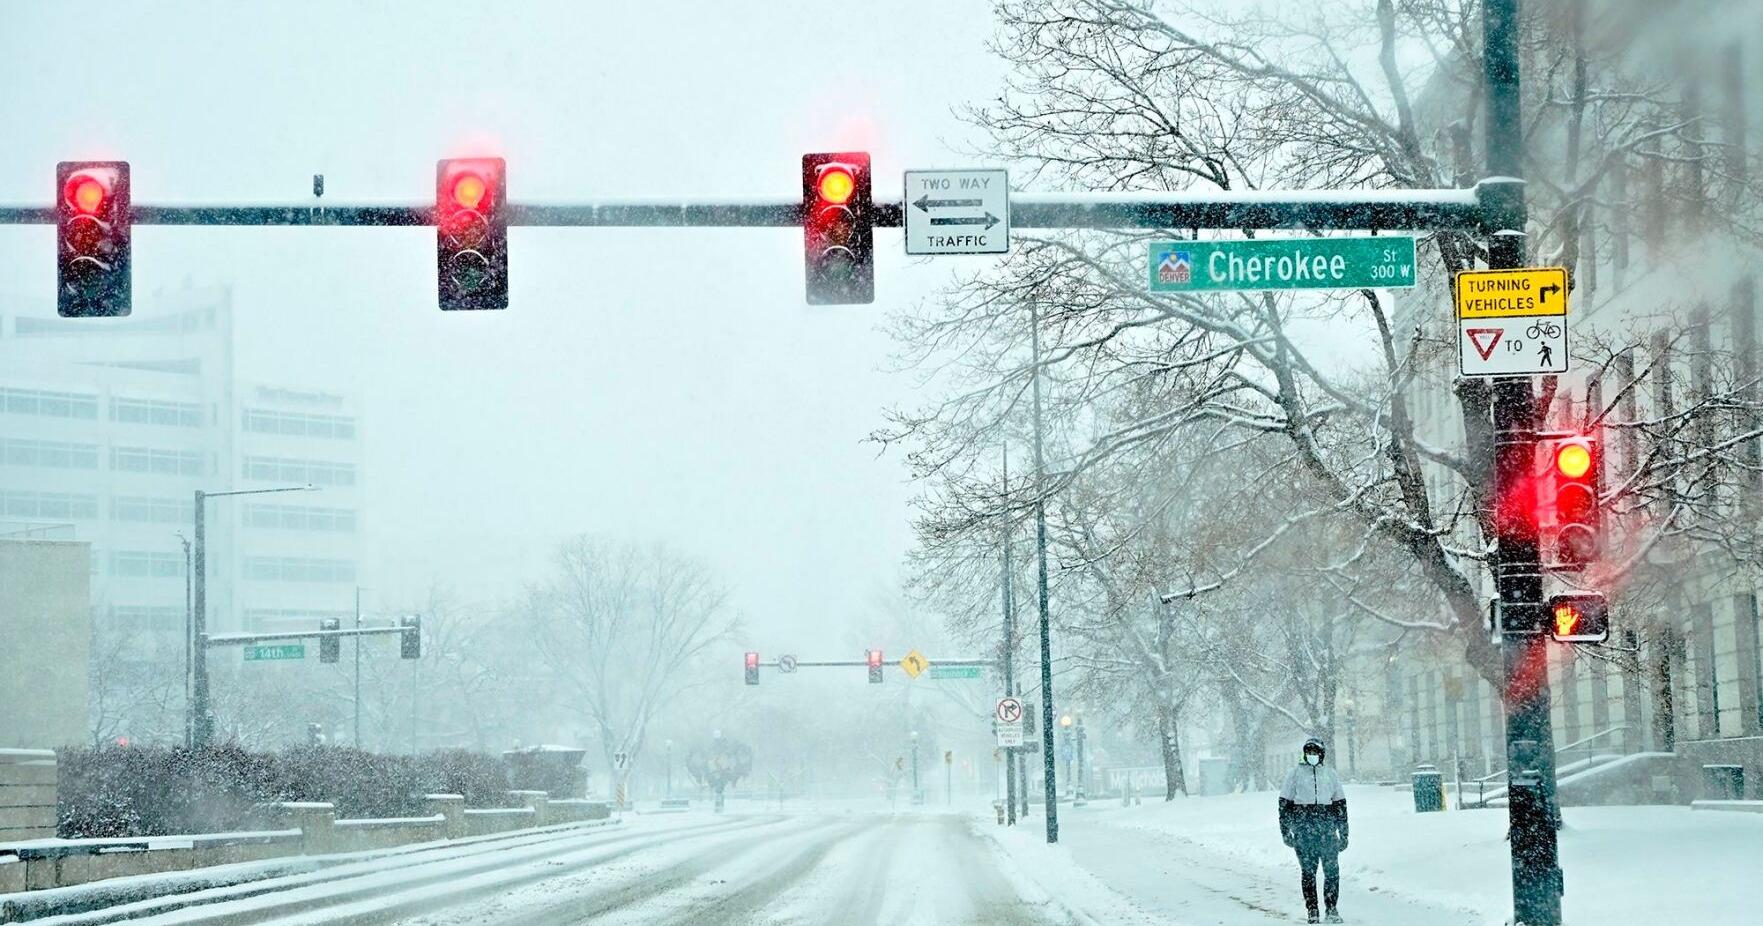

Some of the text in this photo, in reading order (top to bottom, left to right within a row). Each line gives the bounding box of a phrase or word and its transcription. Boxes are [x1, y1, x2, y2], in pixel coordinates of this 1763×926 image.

[921, 177, 990, 190] TWO WAY
[927, 235, 987, 247] TRAFFIC
[1383, 248, 1397, 262] St
[1208, 249, 1346, 282] Cherokee
[1371, 264, 1411, 279] 300 W
[1159, 271, 1189, 282] DENVER
[1468, 278, 1531, 293] TURNING
[1465, 297, 1535, 311] VEHICLES
[1505, 339, 1523, 352] TO
[259, 648, 284, 659] 14th
